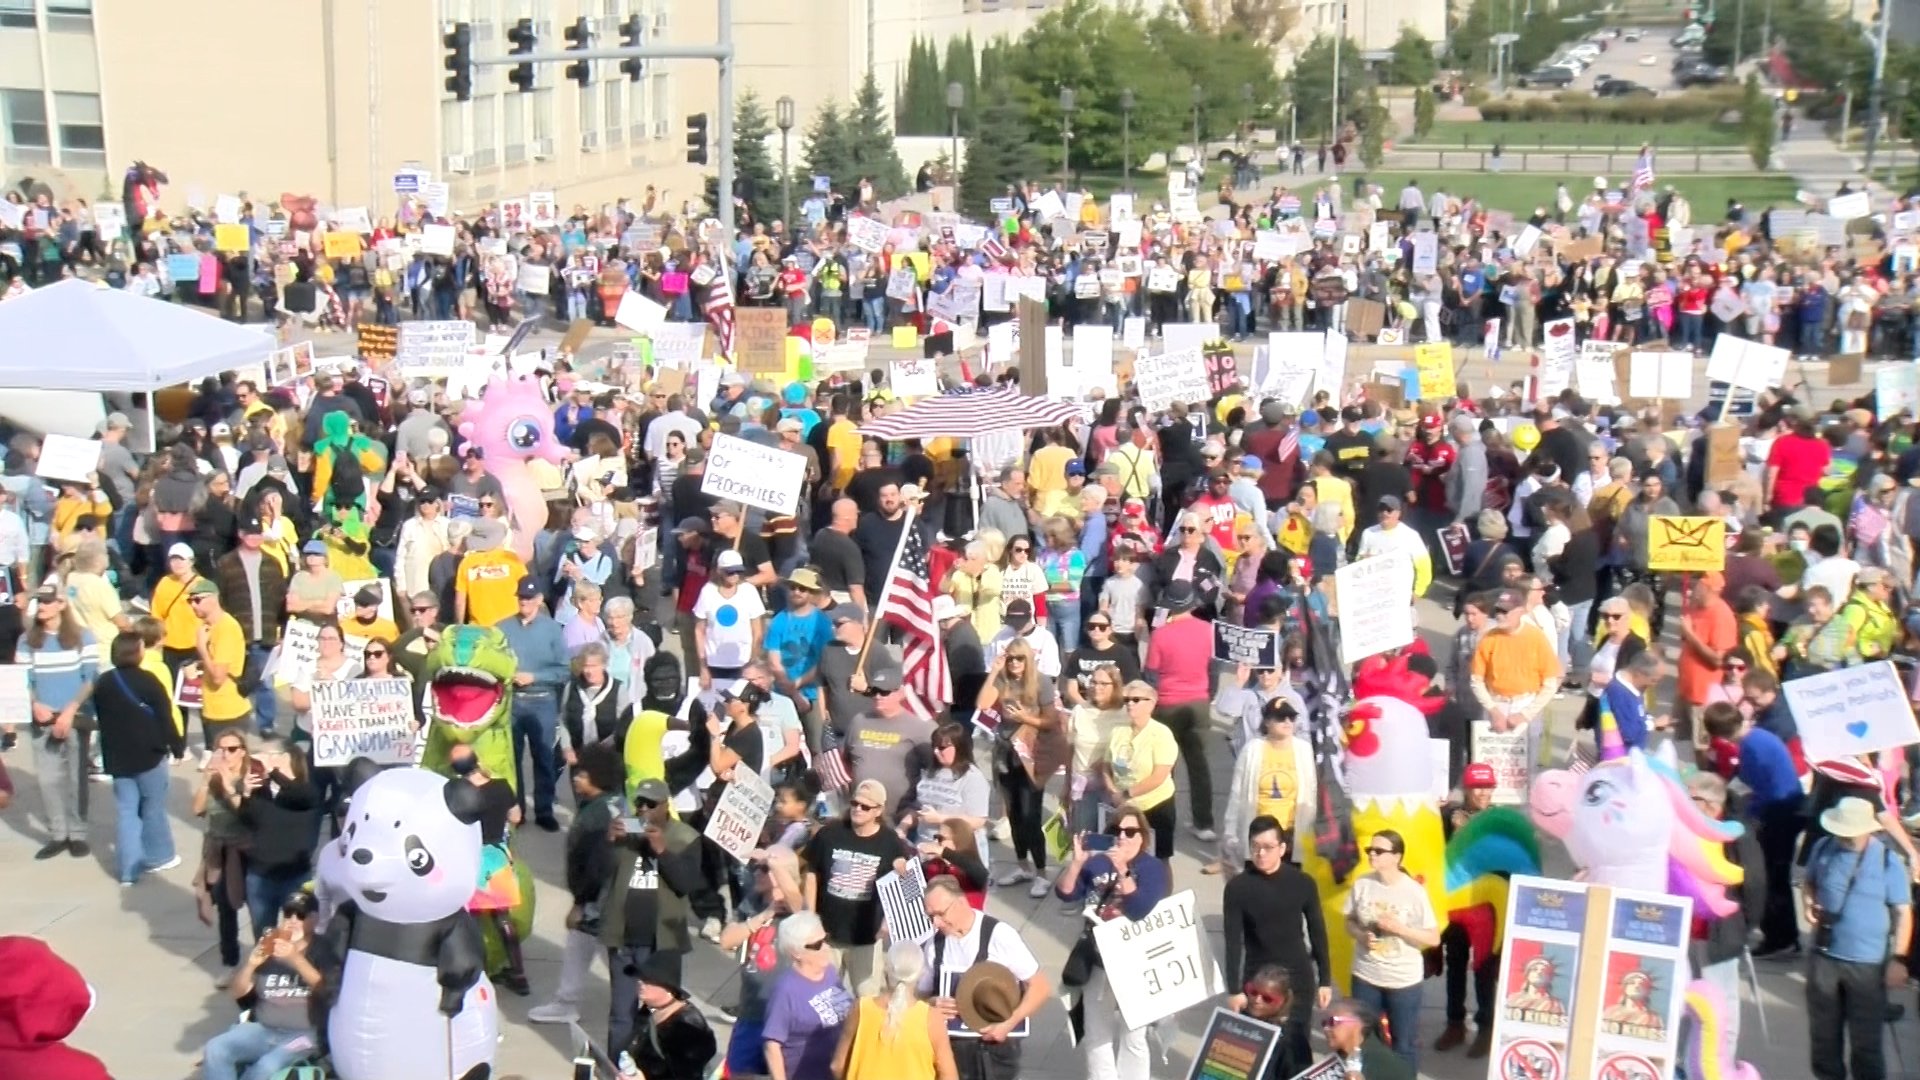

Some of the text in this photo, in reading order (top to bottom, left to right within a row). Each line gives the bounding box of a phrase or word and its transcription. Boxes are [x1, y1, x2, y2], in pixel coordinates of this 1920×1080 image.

[1205, 355, 1235, 376] NO
[312, 680, 410, 702] MY DAUGHTERS
[321, 703, 356, 719] HAVE
[358, 716, 386, 729] THAN
[387, 713, 408, 726] MY
[317, 728, 391, 760] GRANDMA
[716, 808, 753, 843] TRUMP
[1119, 904, 1196, 941] TERROR
[1143, 954, 1198, 995] ICE
[1524, 1008, 1569, 1028] KINGS
[1622, 1022, 1668, 1041] KINGS
